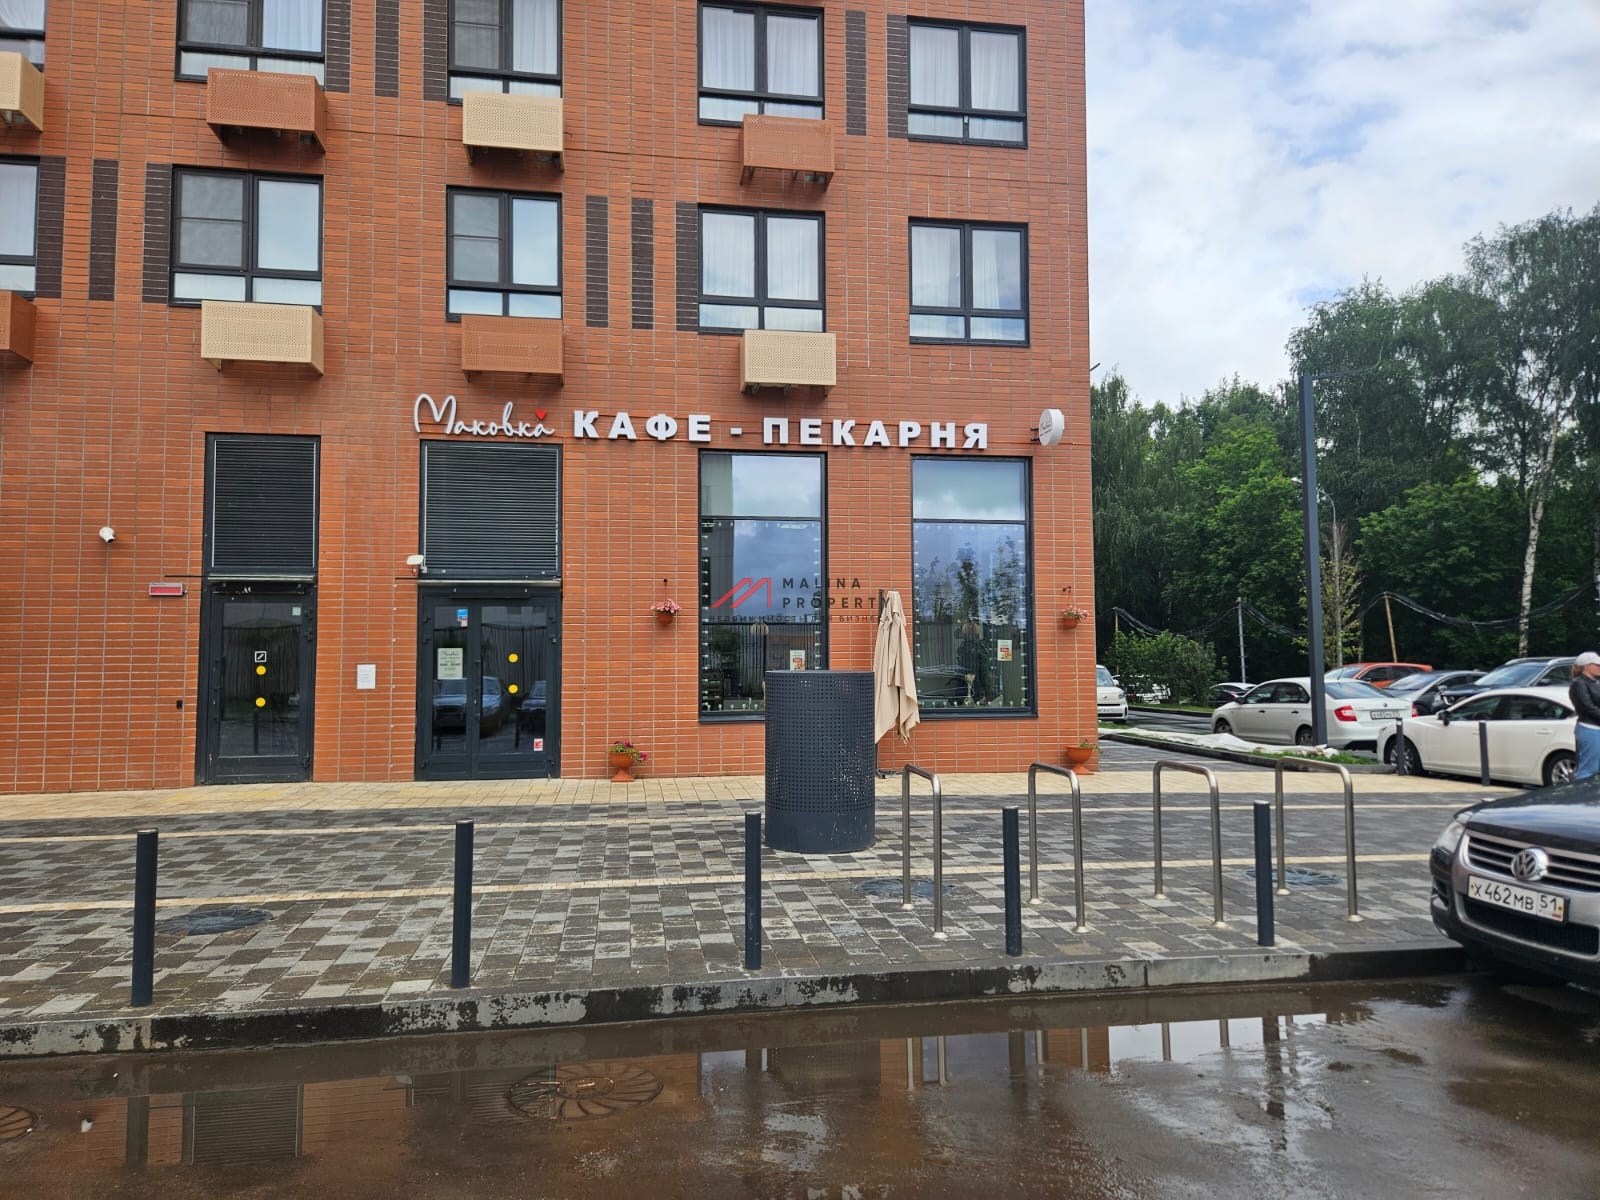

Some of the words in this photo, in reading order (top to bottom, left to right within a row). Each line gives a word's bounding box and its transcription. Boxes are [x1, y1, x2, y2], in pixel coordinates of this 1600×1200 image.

[414, 393, 555, 438] Маковка
[573, 410, 711, 442] КАФЕ
[763, 417, 988, 449] ПЕКАРНЯ
